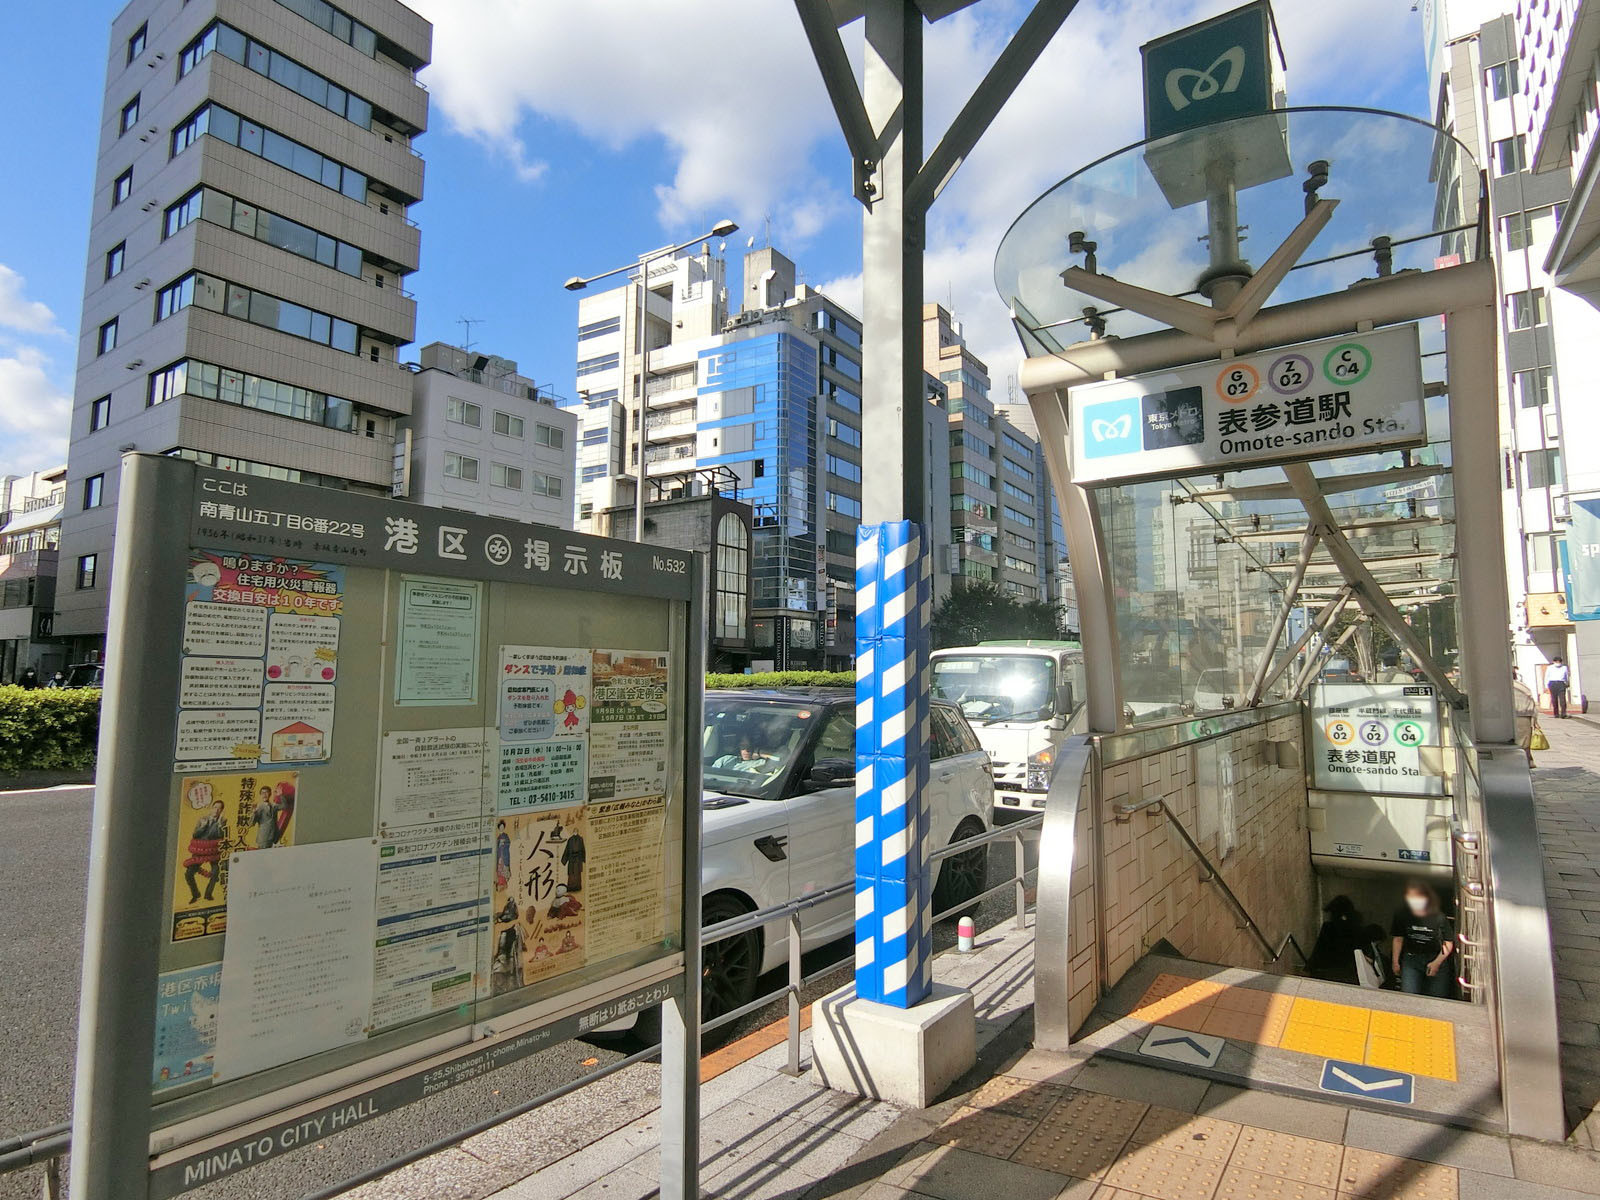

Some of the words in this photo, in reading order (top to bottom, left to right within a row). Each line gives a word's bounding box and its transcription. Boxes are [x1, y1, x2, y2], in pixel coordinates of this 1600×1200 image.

[1341, 350, 1351, 362] C
[1285, 361, 1296, 372] Z
[1230, 371, 1242, 382] G
[1280, 373, 1302, 387] 02
[1226, 381, 1248, 396] 02
[1218, 390, 1352, 436] 表参道駅
[1151, 421, 1172, 430] Tokyo
[1220, 423, 1354, 456] Omote-sando
[1363, 416, 1406, 436] Sta.
[202, 478, 248, 498] ここは
[200, 501, 365, 540] 南青山五丁目6番22号
[384, 516, 469, 561] 港区
[524, 538, 624, 581] 掲示板
[652, 554, 686, 574] No.532
[236, 574, 337, 594] 住宅用火災警報器
[594, 688, 664, 700] 港区議会定例会
[1418, 687, 1432, 696] B1
[1333, 732, 1347, 740] 02
[1367, 733, 1381, 741] 02
[1401, 733, 1416, 742] 04
[1328, 749, 1396, 765] 表参道駅
[1328, 764, 1398, 776] Omote-sando
[524, 830, 554, 901] 人形
[578, 984, 671, 1032] 無断はり紙おことわり
[423, 1078, 450, 1095] Phone
[455, 1060, 496, 1084] 3578-2111
[184, 1136, 273, 1186] MINATO
[280, 1116, 326, 1148] CITY
[332, 1098, 379, 1129] HALL
